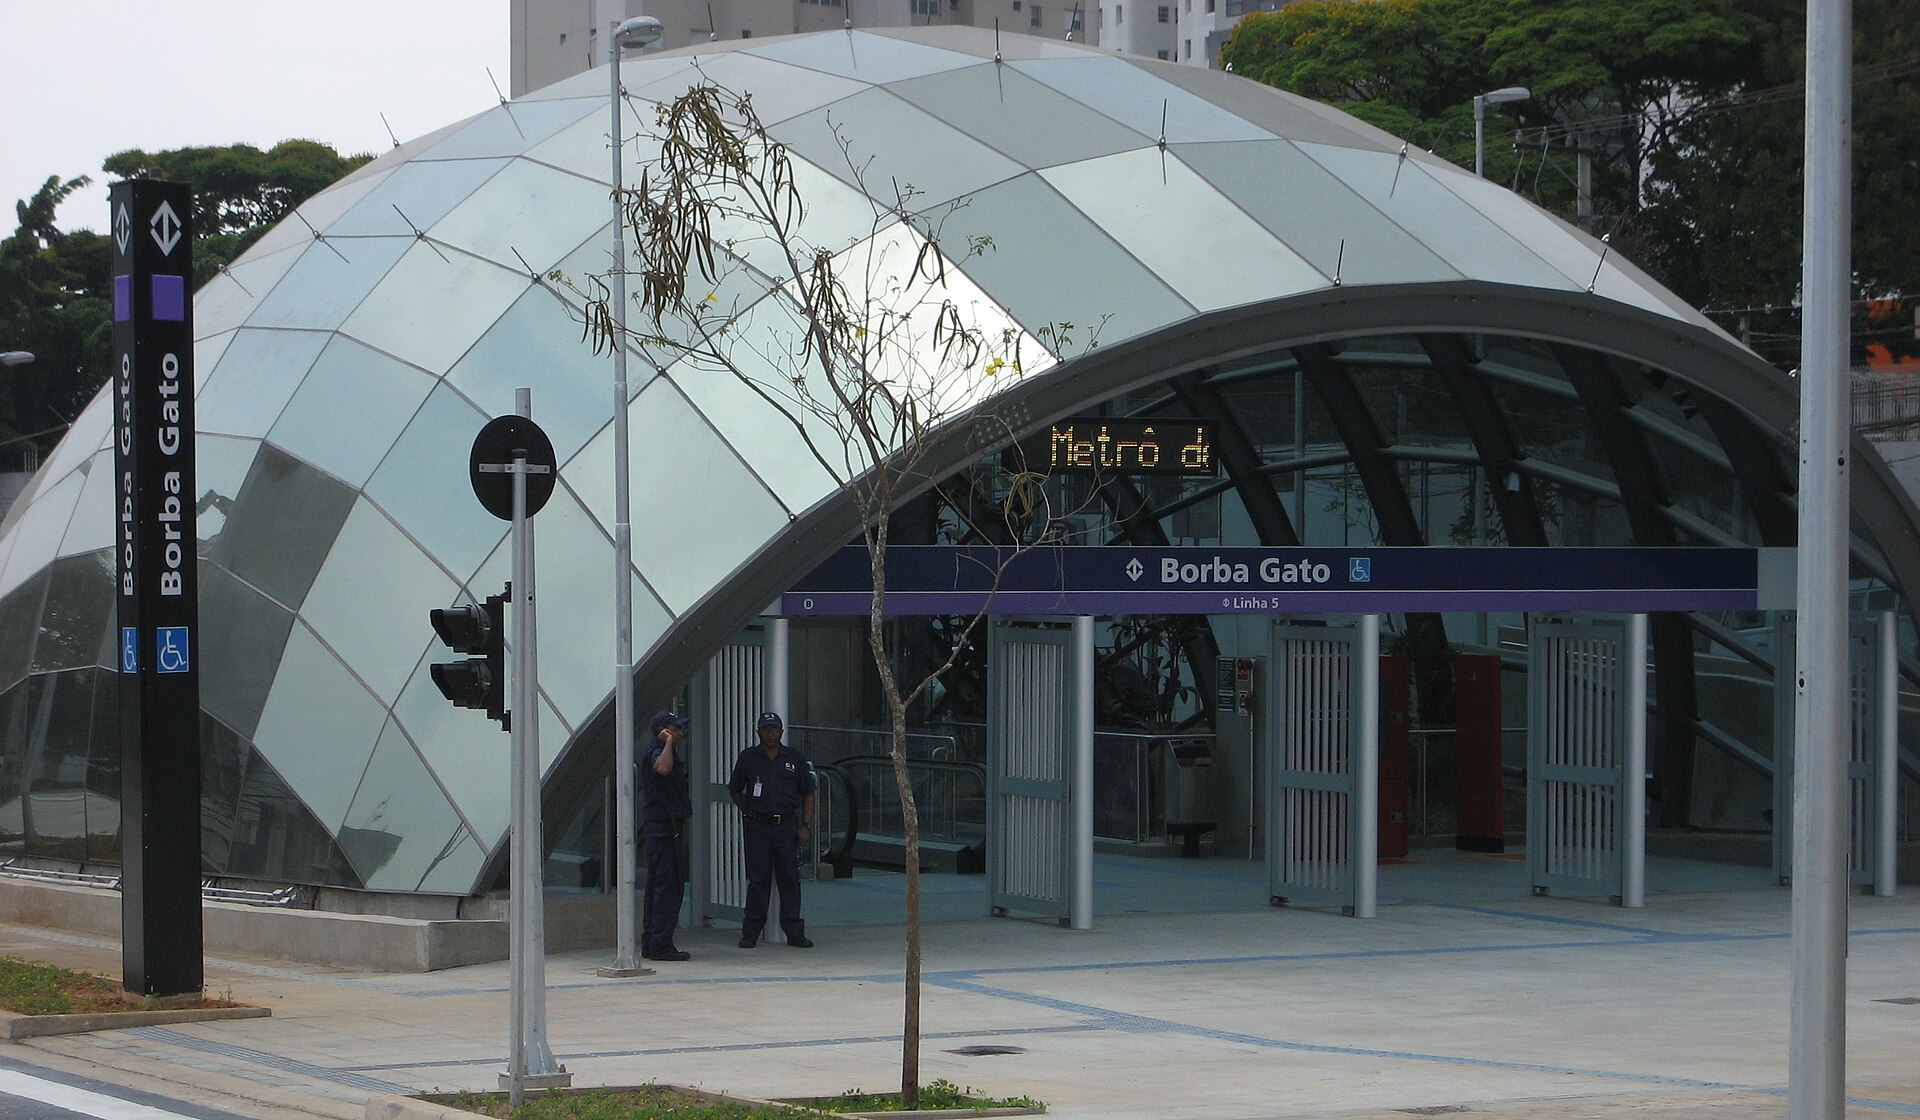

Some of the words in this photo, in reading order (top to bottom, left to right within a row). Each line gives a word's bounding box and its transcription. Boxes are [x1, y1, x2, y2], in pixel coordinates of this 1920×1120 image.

[121, 352, 131, 456] Gato
[158, 352, 180, 456] Gato
[1051, 425, 1160, 467] Metrô
[121, 471, 133, 596] Borba
[158, 471, 182, 596] Borba
[1160, 555, 1250, 584] Borba
[1259, 557, 1331, 584] Gato
[1233, 597, 1268, 609] Linha
[1271, 597, 1279, 609] 5
